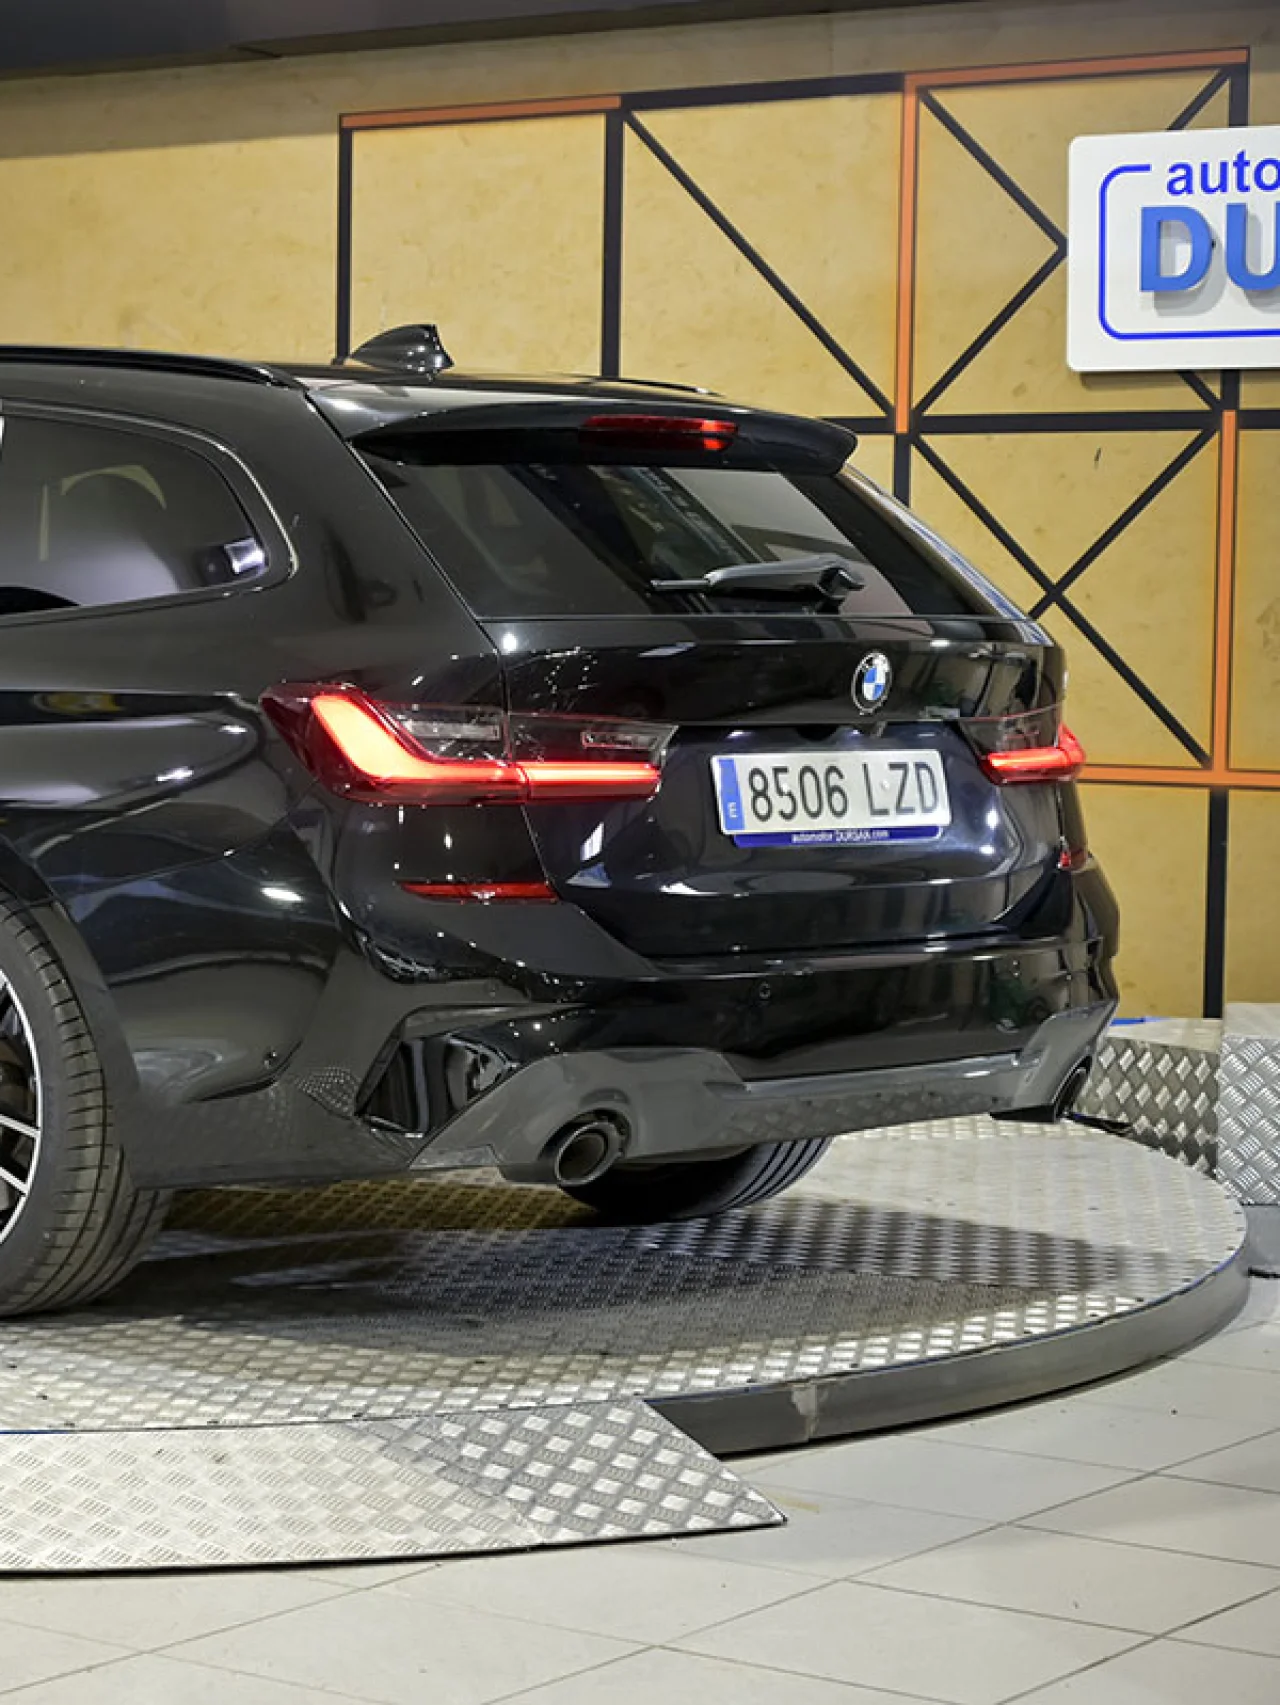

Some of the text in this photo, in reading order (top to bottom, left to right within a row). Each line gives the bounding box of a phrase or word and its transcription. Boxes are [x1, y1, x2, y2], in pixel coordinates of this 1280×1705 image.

[1166, 150, 1280, 196] auto
[1140, 201, 1280, 293] DU
[748, 762, 939, 822] 8506 LZD
